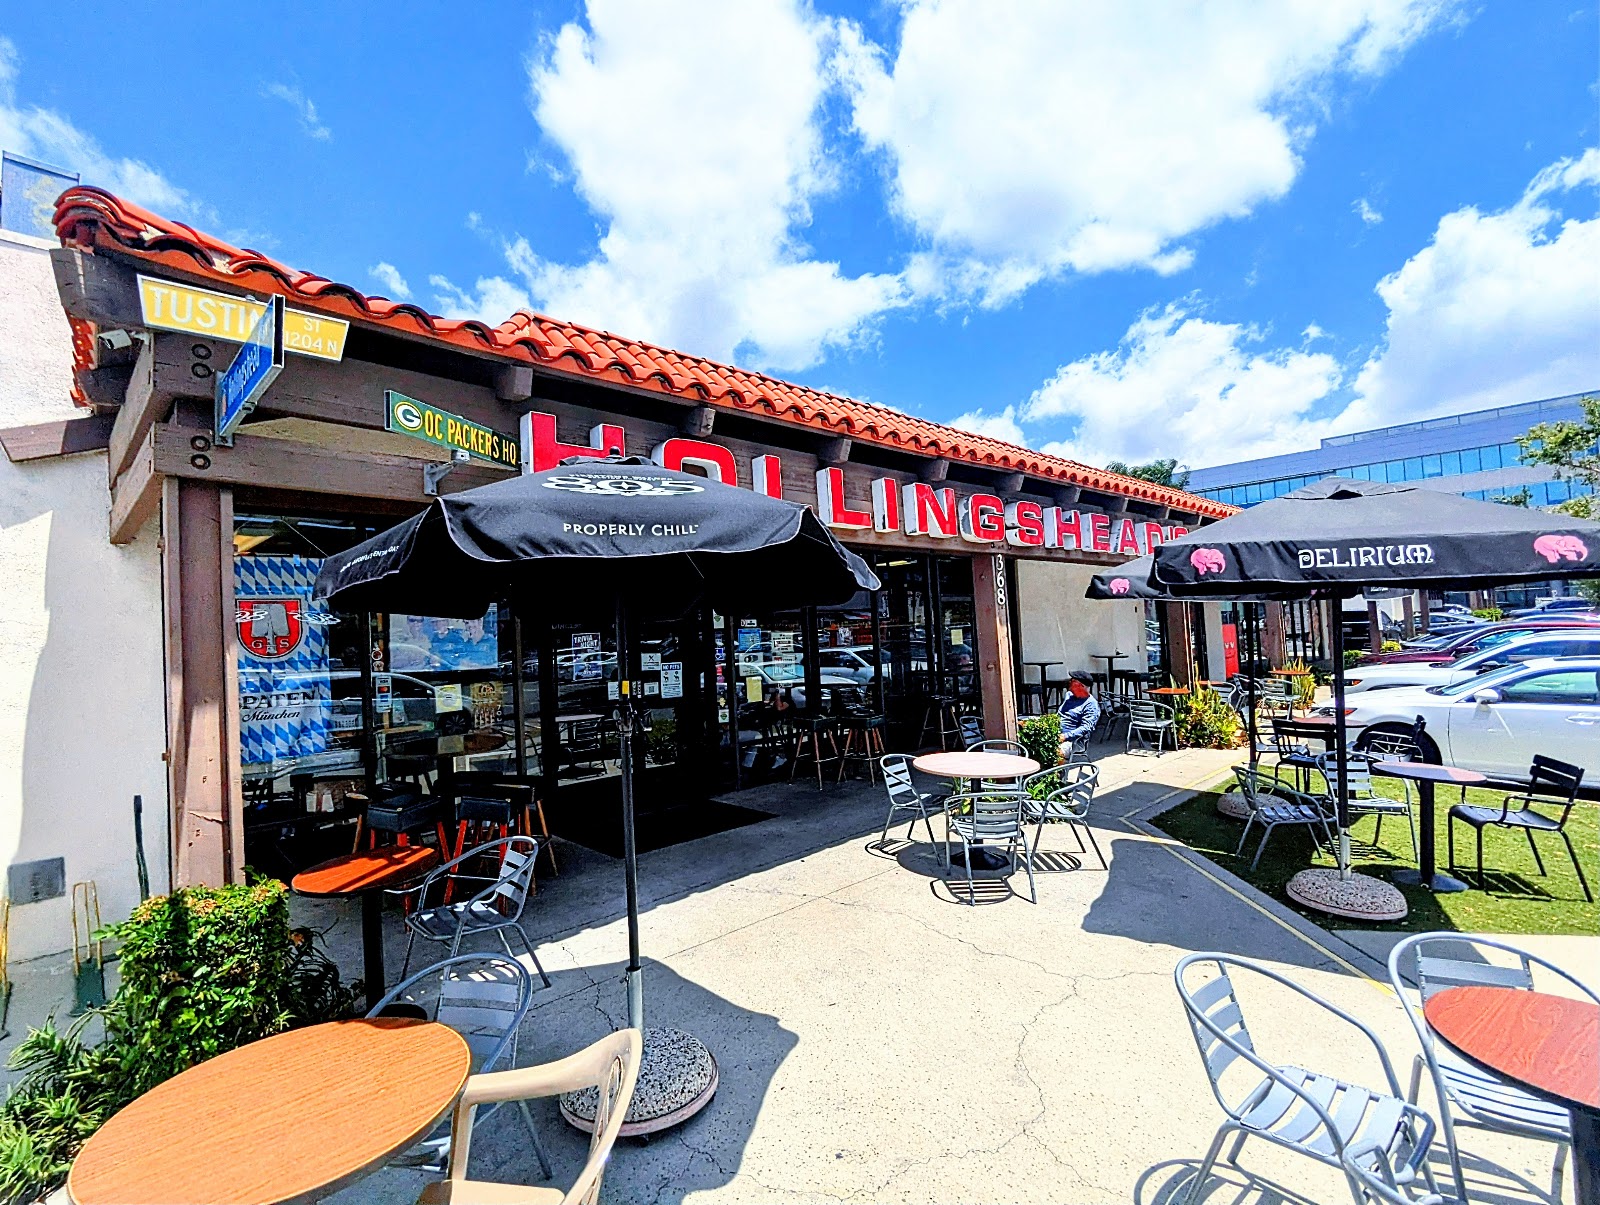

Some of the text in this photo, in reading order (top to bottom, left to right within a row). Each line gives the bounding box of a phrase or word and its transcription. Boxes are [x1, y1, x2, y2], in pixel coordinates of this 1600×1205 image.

[303, 318, 323, 333] ST
[285, 331, 338, 354] 1204 N
[424, 409, 443, 440] OC
[447, 418, 500, 459] PACKERS
[502, 439, 517, 465] HQ
[541, 476, 706, 496] 805
[563, 522, 646, 536] PROPERLY
[1297, 544, 1434, 569] DELIRIUM
[996, 553, 1006, 605] 368
[251, 638, 290, 649] G S
[239, 686, 319, 710] PATEN
[241, 709, 301, 722] München
